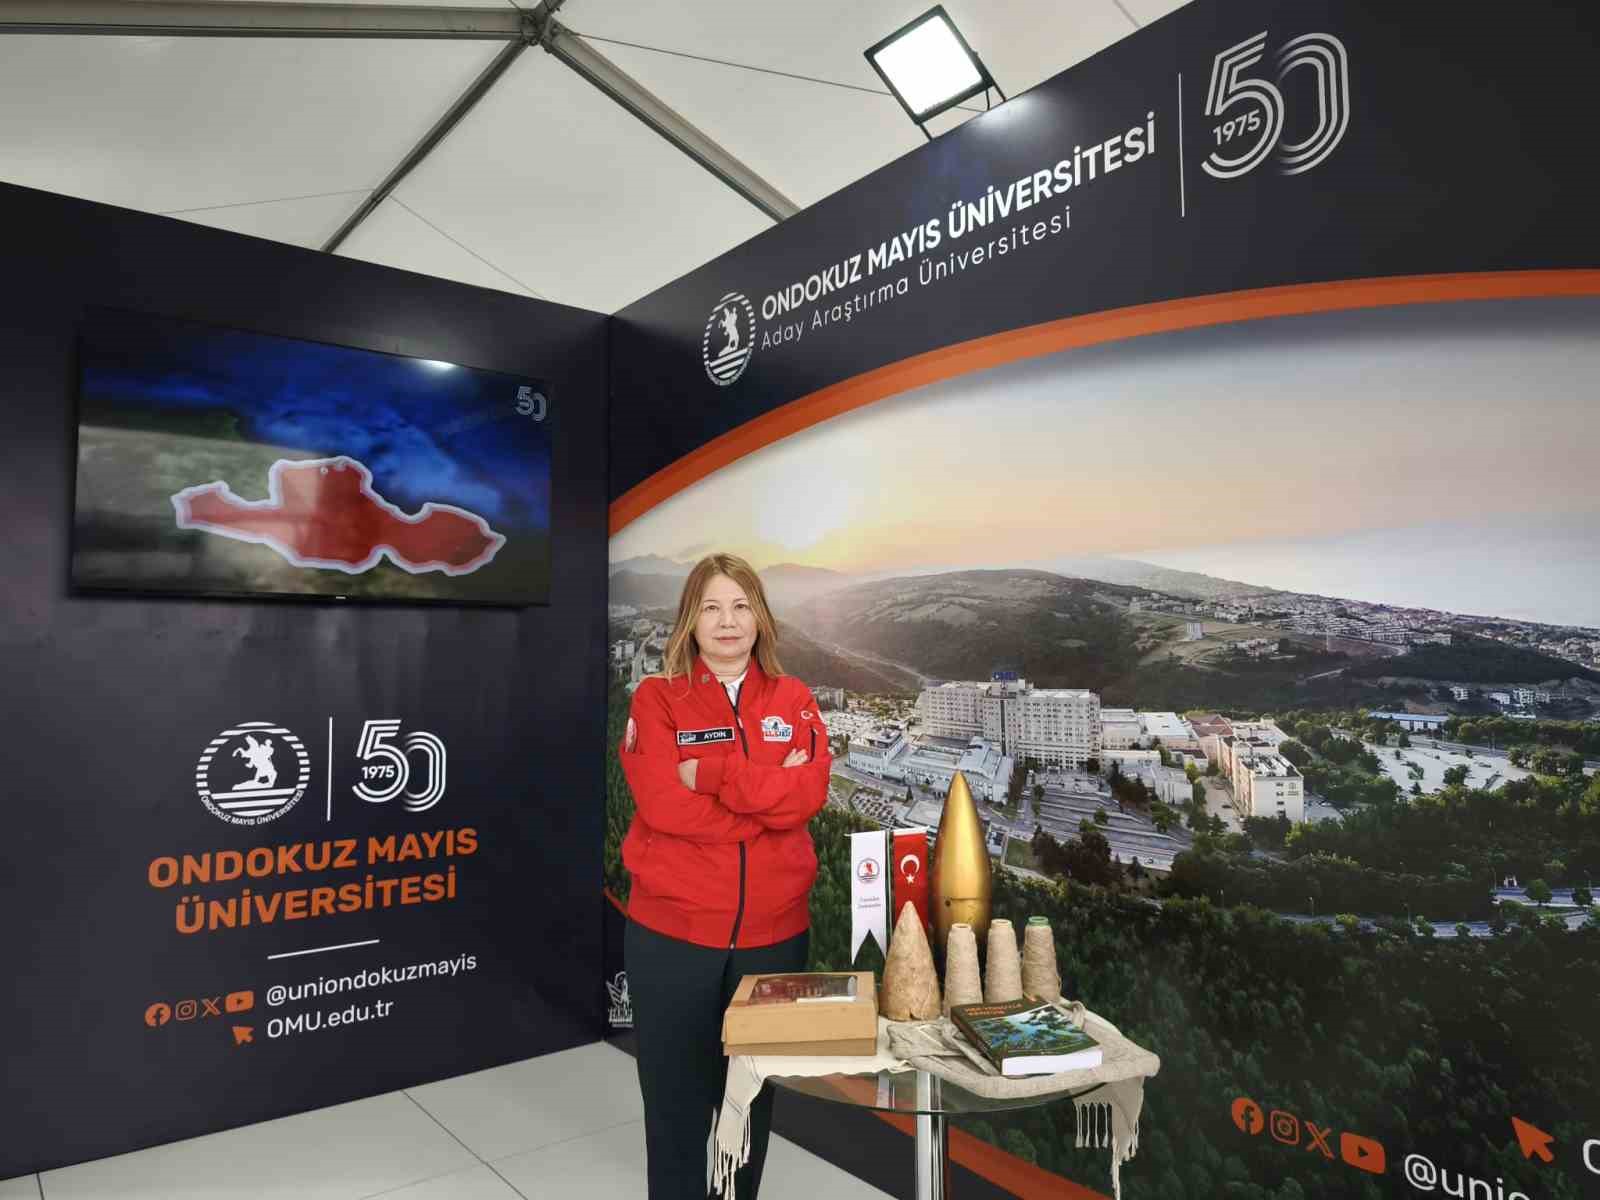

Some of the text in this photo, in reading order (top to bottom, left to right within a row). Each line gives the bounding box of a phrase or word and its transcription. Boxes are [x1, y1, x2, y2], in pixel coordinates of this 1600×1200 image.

[1201, 30, 1350, 178] 50
[1213, 109, 1261, 145] 1975
[761, 111, 1155, 320] ONDOKUZ MAYIS ÜNİVERSİTESİ
[761, 205, 1072, 350] Aday Araştırma Üniversitesi
[352, 719, 447, 813] 50
[703, 730, 727, 741] AYDIN
[361, 765, 395, 779] 1975
[148, 827, 479, 889] ONDOKUZ MAYIS
[175, 865, 457, 935] ÜNİVERSİTESİ
[266, 953, 477, 1007] @uniondokuzmayis
[267, 999, 393, 1039] OMU.edu.tr
